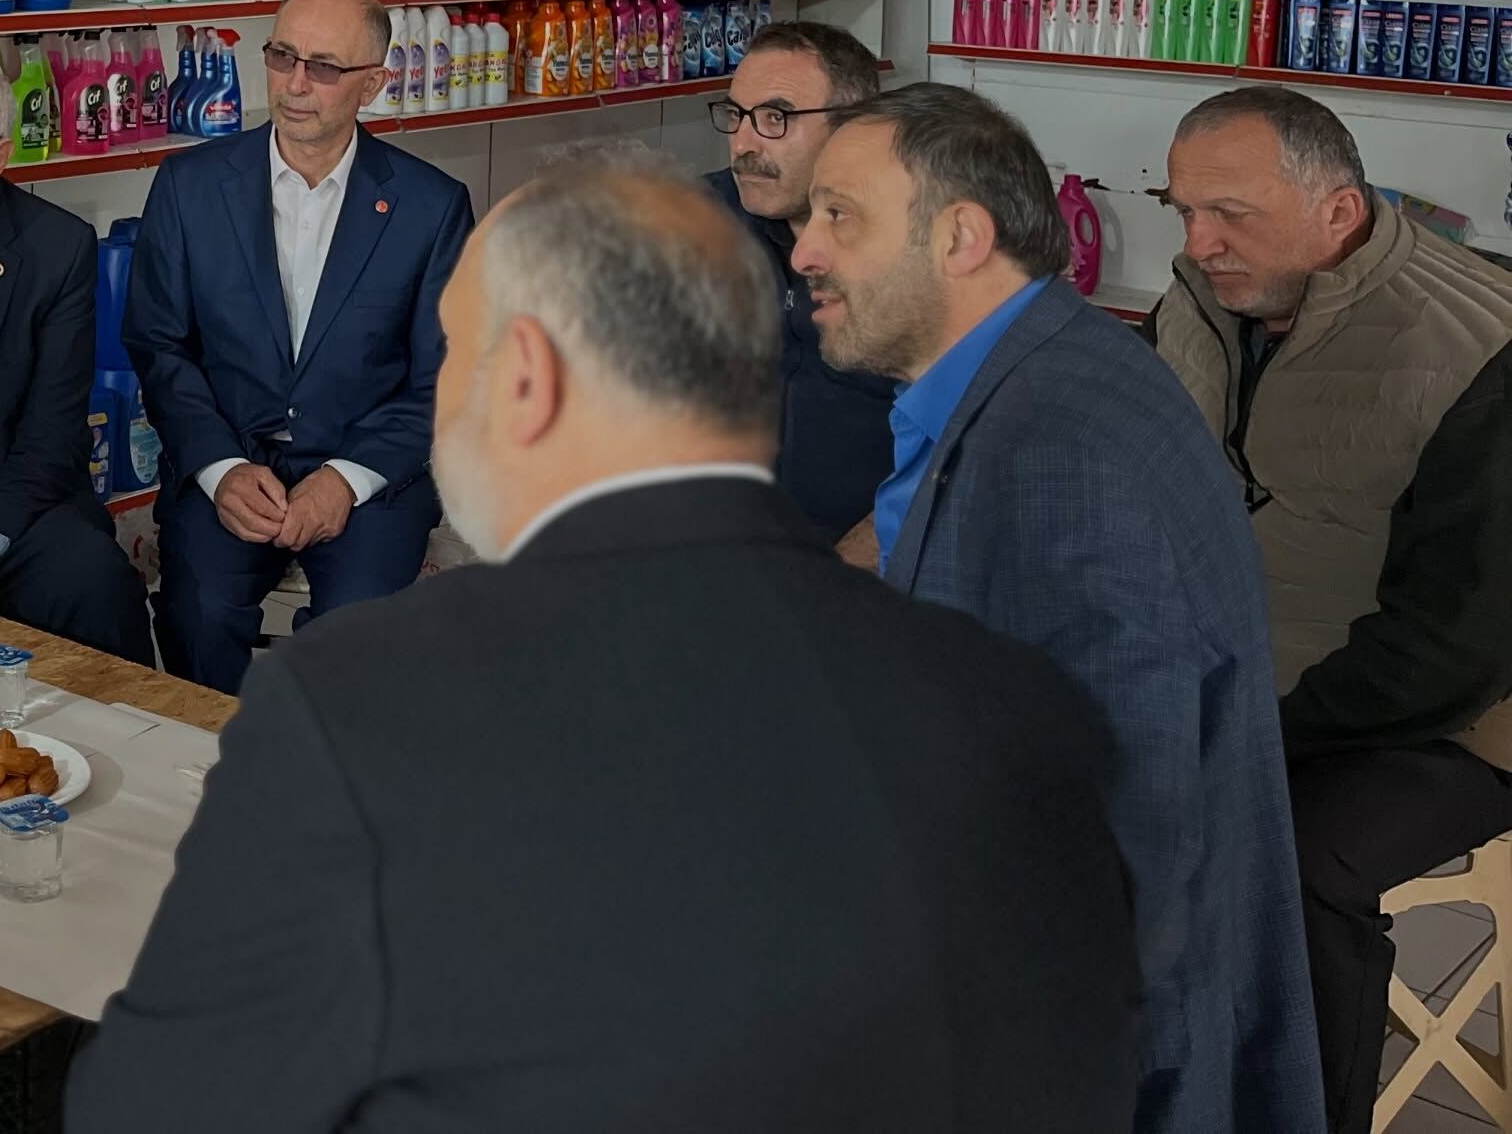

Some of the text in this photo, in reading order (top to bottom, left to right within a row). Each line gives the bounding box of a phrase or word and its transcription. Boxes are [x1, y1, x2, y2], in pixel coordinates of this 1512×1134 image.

[150, 76, 161, 92] Cif
[30, 94, 43, 111] Cif
[88, 91, 100, 105] Cif
